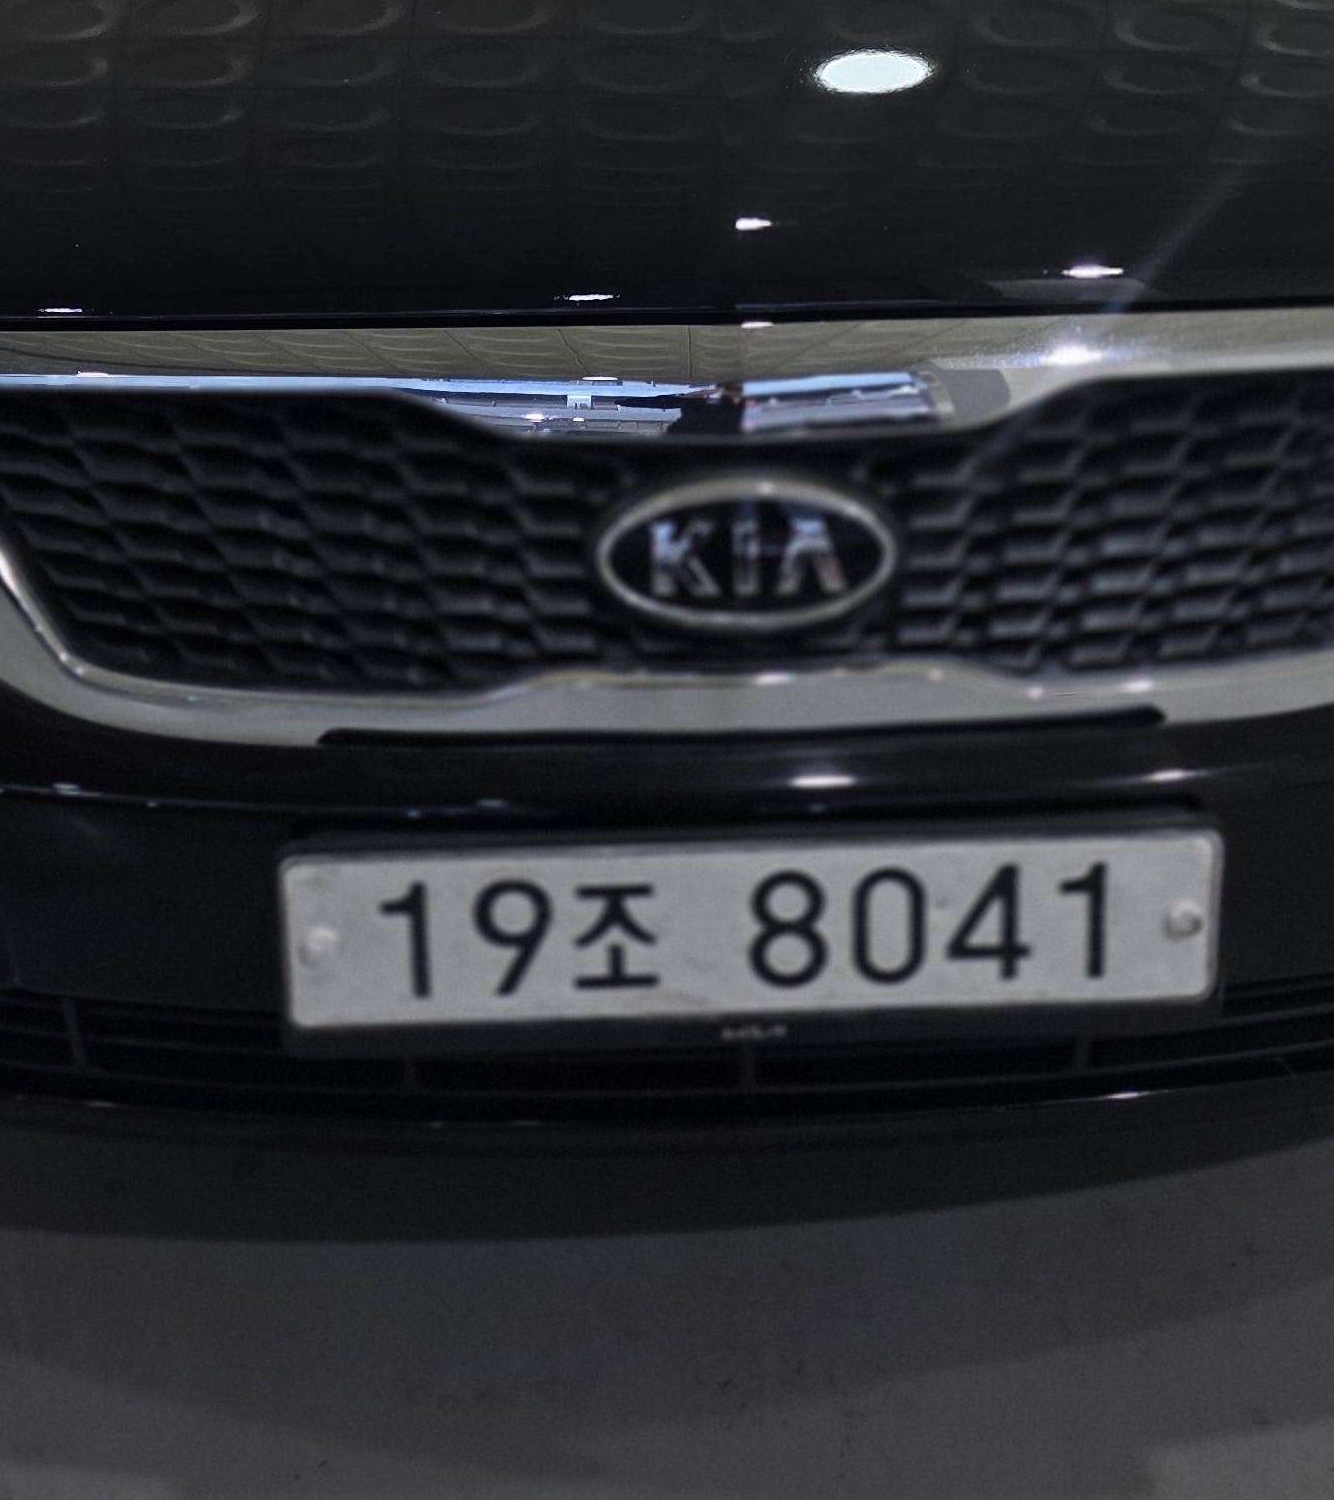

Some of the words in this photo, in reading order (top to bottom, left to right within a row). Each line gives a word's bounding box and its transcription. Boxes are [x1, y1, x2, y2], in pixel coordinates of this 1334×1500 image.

[650, 517, 847, 597] KIA
[377, 876, 661, 1000] 19조
[745, 859, 1110, 991] 8041
